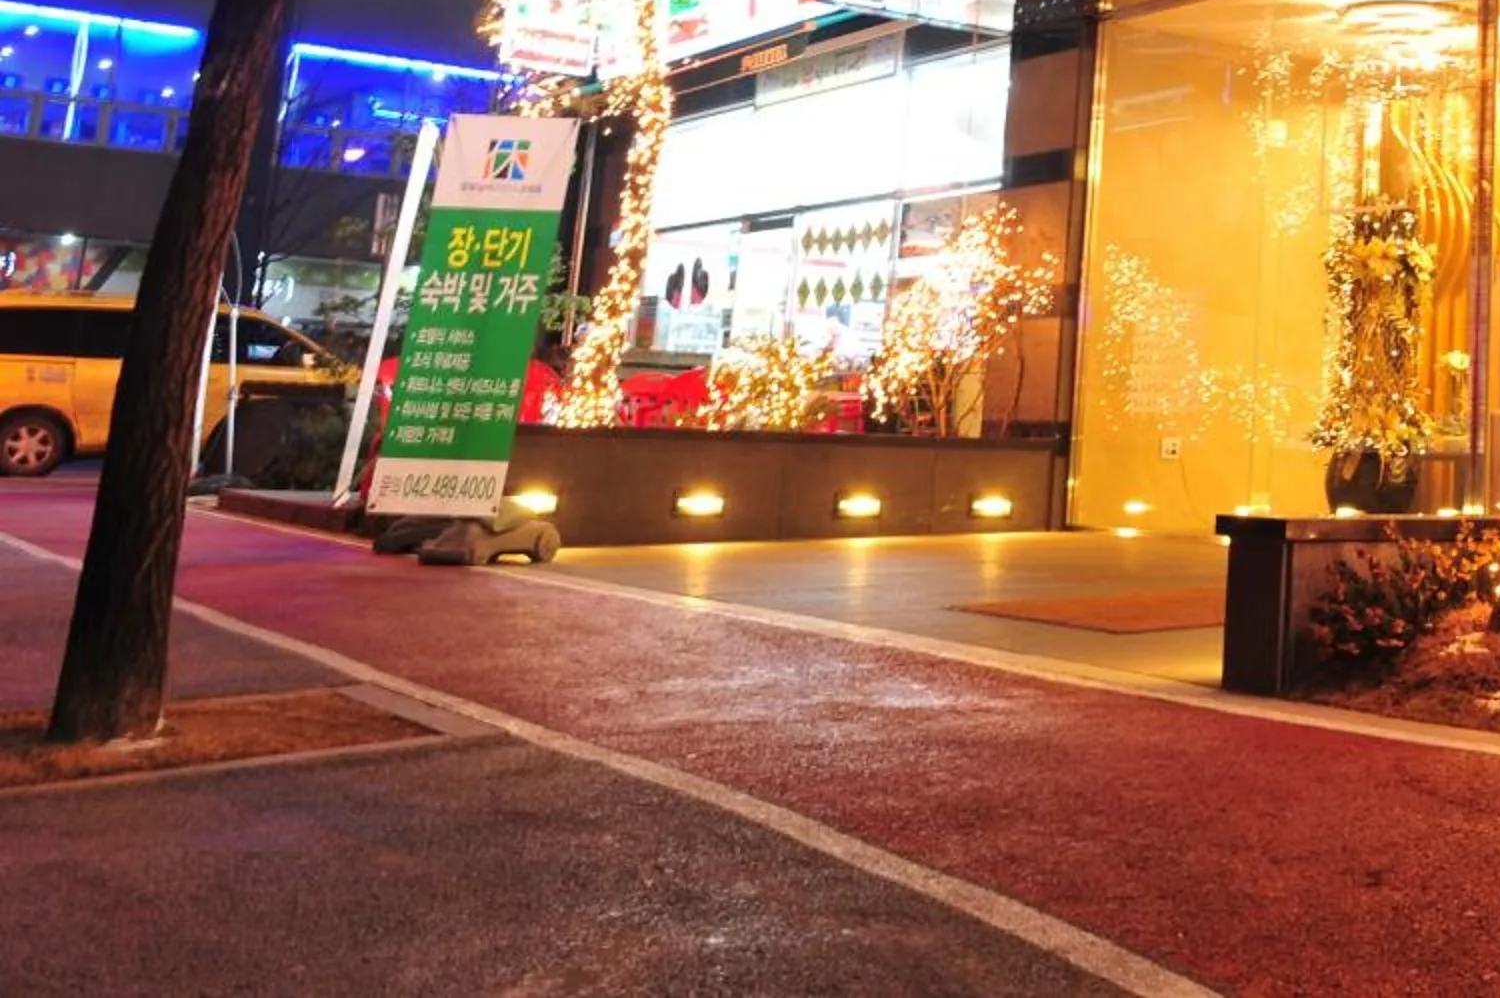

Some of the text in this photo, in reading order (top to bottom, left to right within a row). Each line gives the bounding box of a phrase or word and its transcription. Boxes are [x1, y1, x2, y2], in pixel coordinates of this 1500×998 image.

[419, 270, 540, 314] 숙박 및 거주
